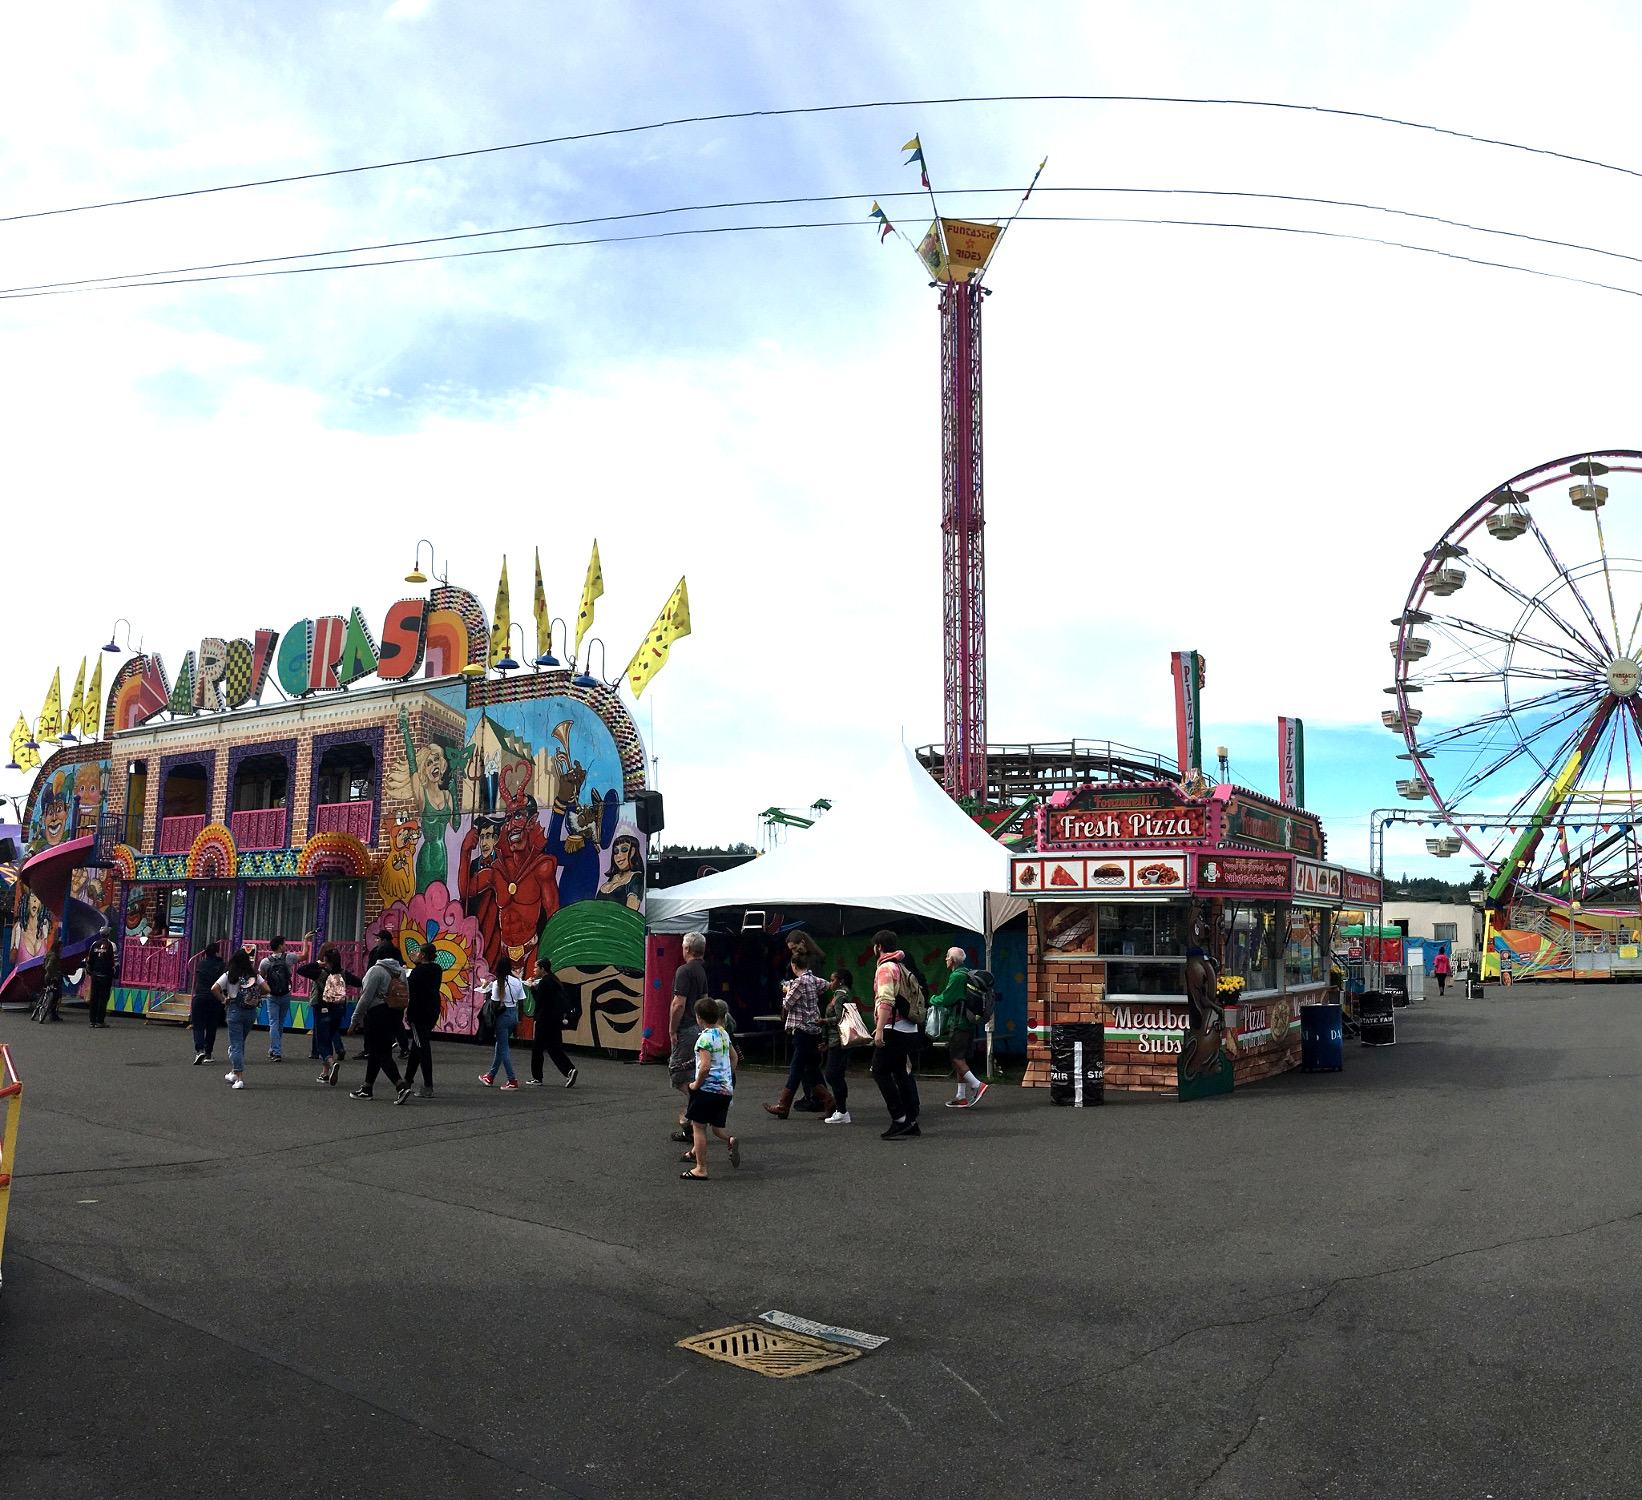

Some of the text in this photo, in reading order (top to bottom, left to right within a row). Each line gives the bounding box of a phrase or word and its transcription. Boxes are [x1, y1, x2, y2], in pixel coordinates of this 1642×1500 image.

[947, 225, 996, 240] FUNTASTIC
[956, 249, 982, 261] RIDES
[137, 598, 430, 725] MARDI GRAS
[1285, 727, 1294, 798] PIZZA
[1060, 813, 1191, 839] Fresh Pizza
[1244, 1004, 1266, 1031] Pizza
[1138, 1033, 1182, 1053] Subs
[1051, 1072, 1068, 1081] FAIR
[780, 1320, 821, 1337] UMPING!
